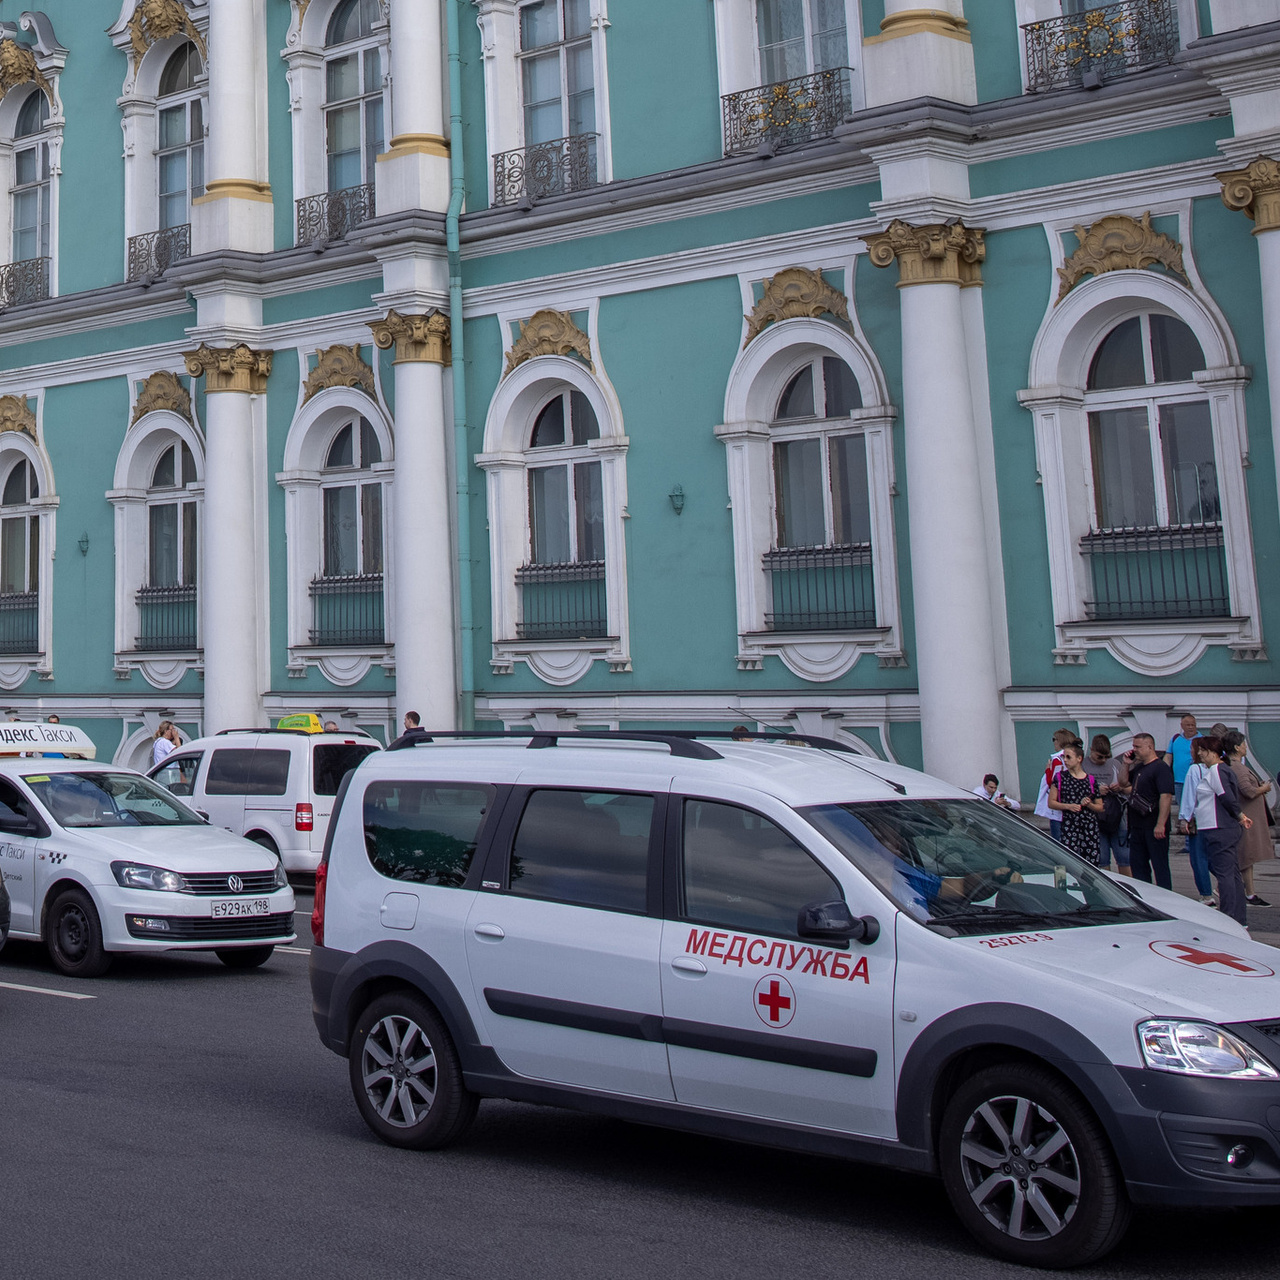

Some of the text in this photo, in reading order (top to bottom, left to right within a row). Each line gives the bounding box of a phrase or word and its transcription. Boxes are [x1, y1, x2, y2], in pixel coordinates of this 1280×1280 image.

[35, 724, 77, 743] Такси
[5, 842, 26, 860] Такси
[214, 900, 268, 916] Е929АК 198
[685, 928, 870, 985] МЕДСЛУЖБА
